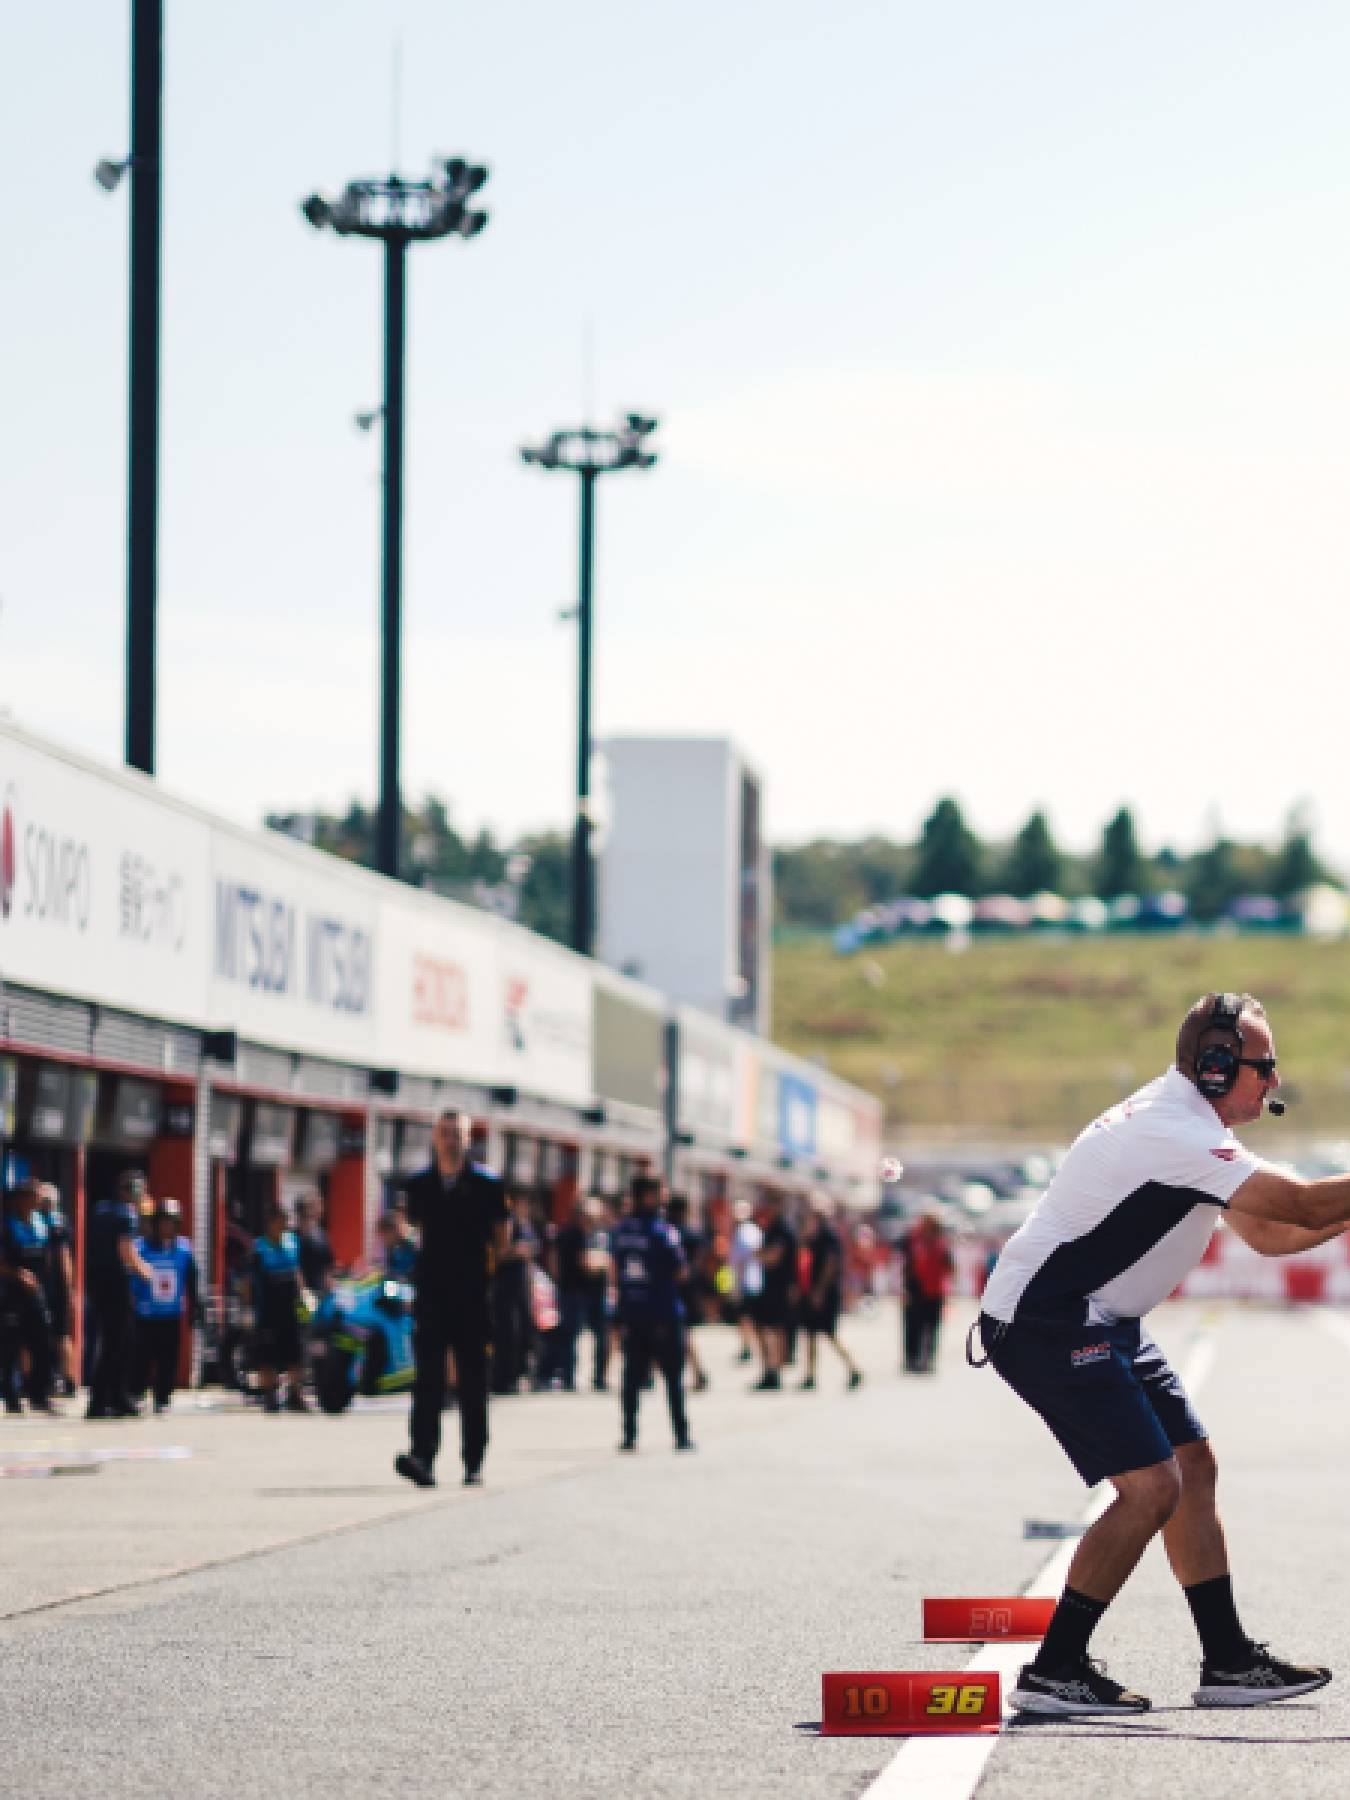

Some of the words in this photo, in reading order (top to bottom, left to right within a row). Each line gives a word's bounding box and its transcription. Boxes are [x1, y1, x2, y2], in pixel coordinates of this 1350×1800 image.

[23, 820, 90, 933] SOMPO
[844, 1685, 889, 1716] 10
[926, 1685, 987, 1715] 36
